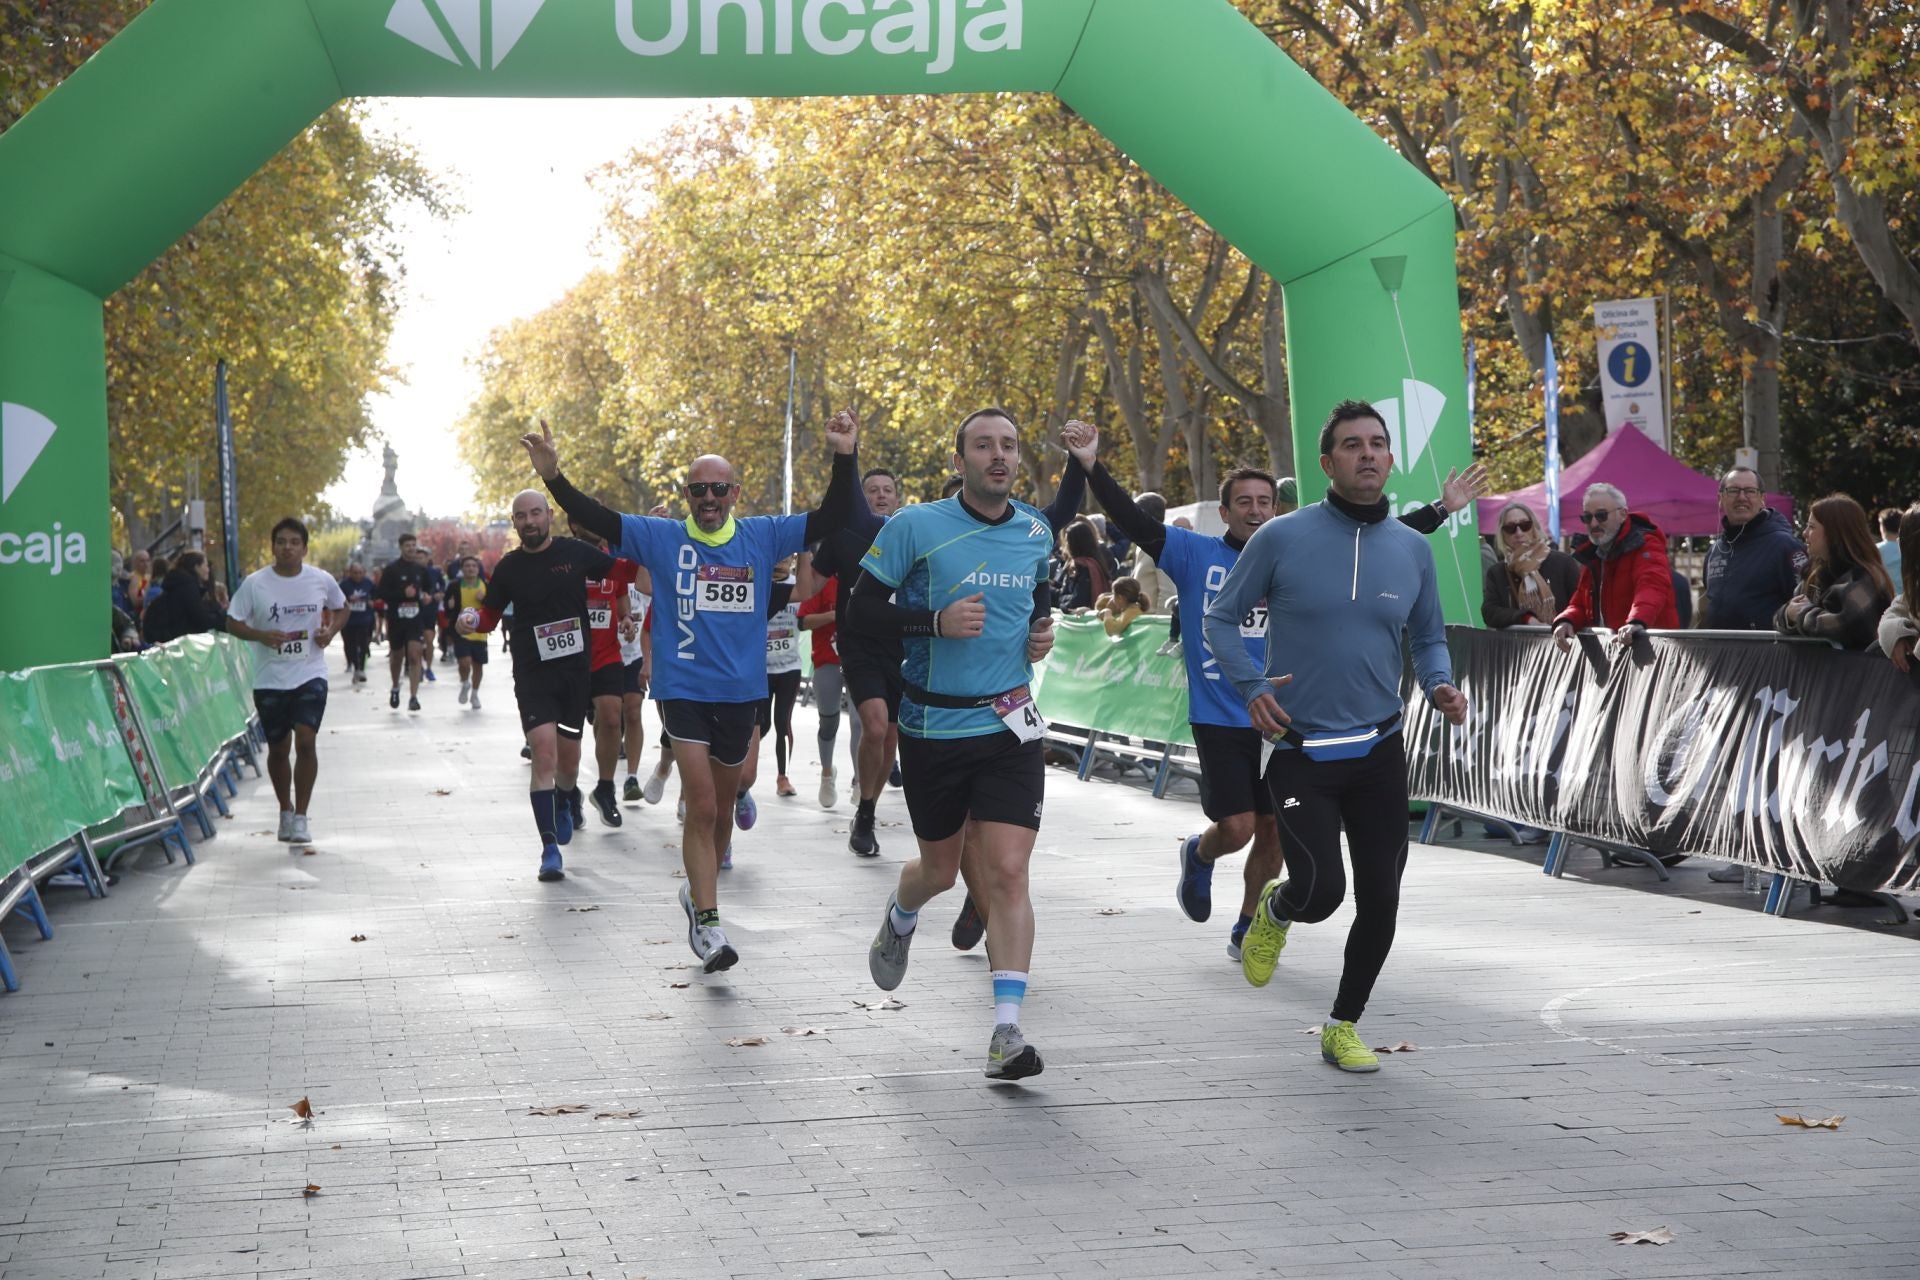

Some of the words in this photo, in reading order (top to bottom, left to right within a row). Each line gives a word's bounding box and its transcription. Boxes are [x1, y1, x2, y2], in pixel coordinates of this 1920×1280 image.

[615, 0, 1022, 74] Unicaja
[961, 571, 1033, 588] ADIENT
[676, 544, 697, 660] IVECO
[705, 583, 748, 603] 589
[546, 632, 576, 651] 968
[767, 639, 790, 651] 536
